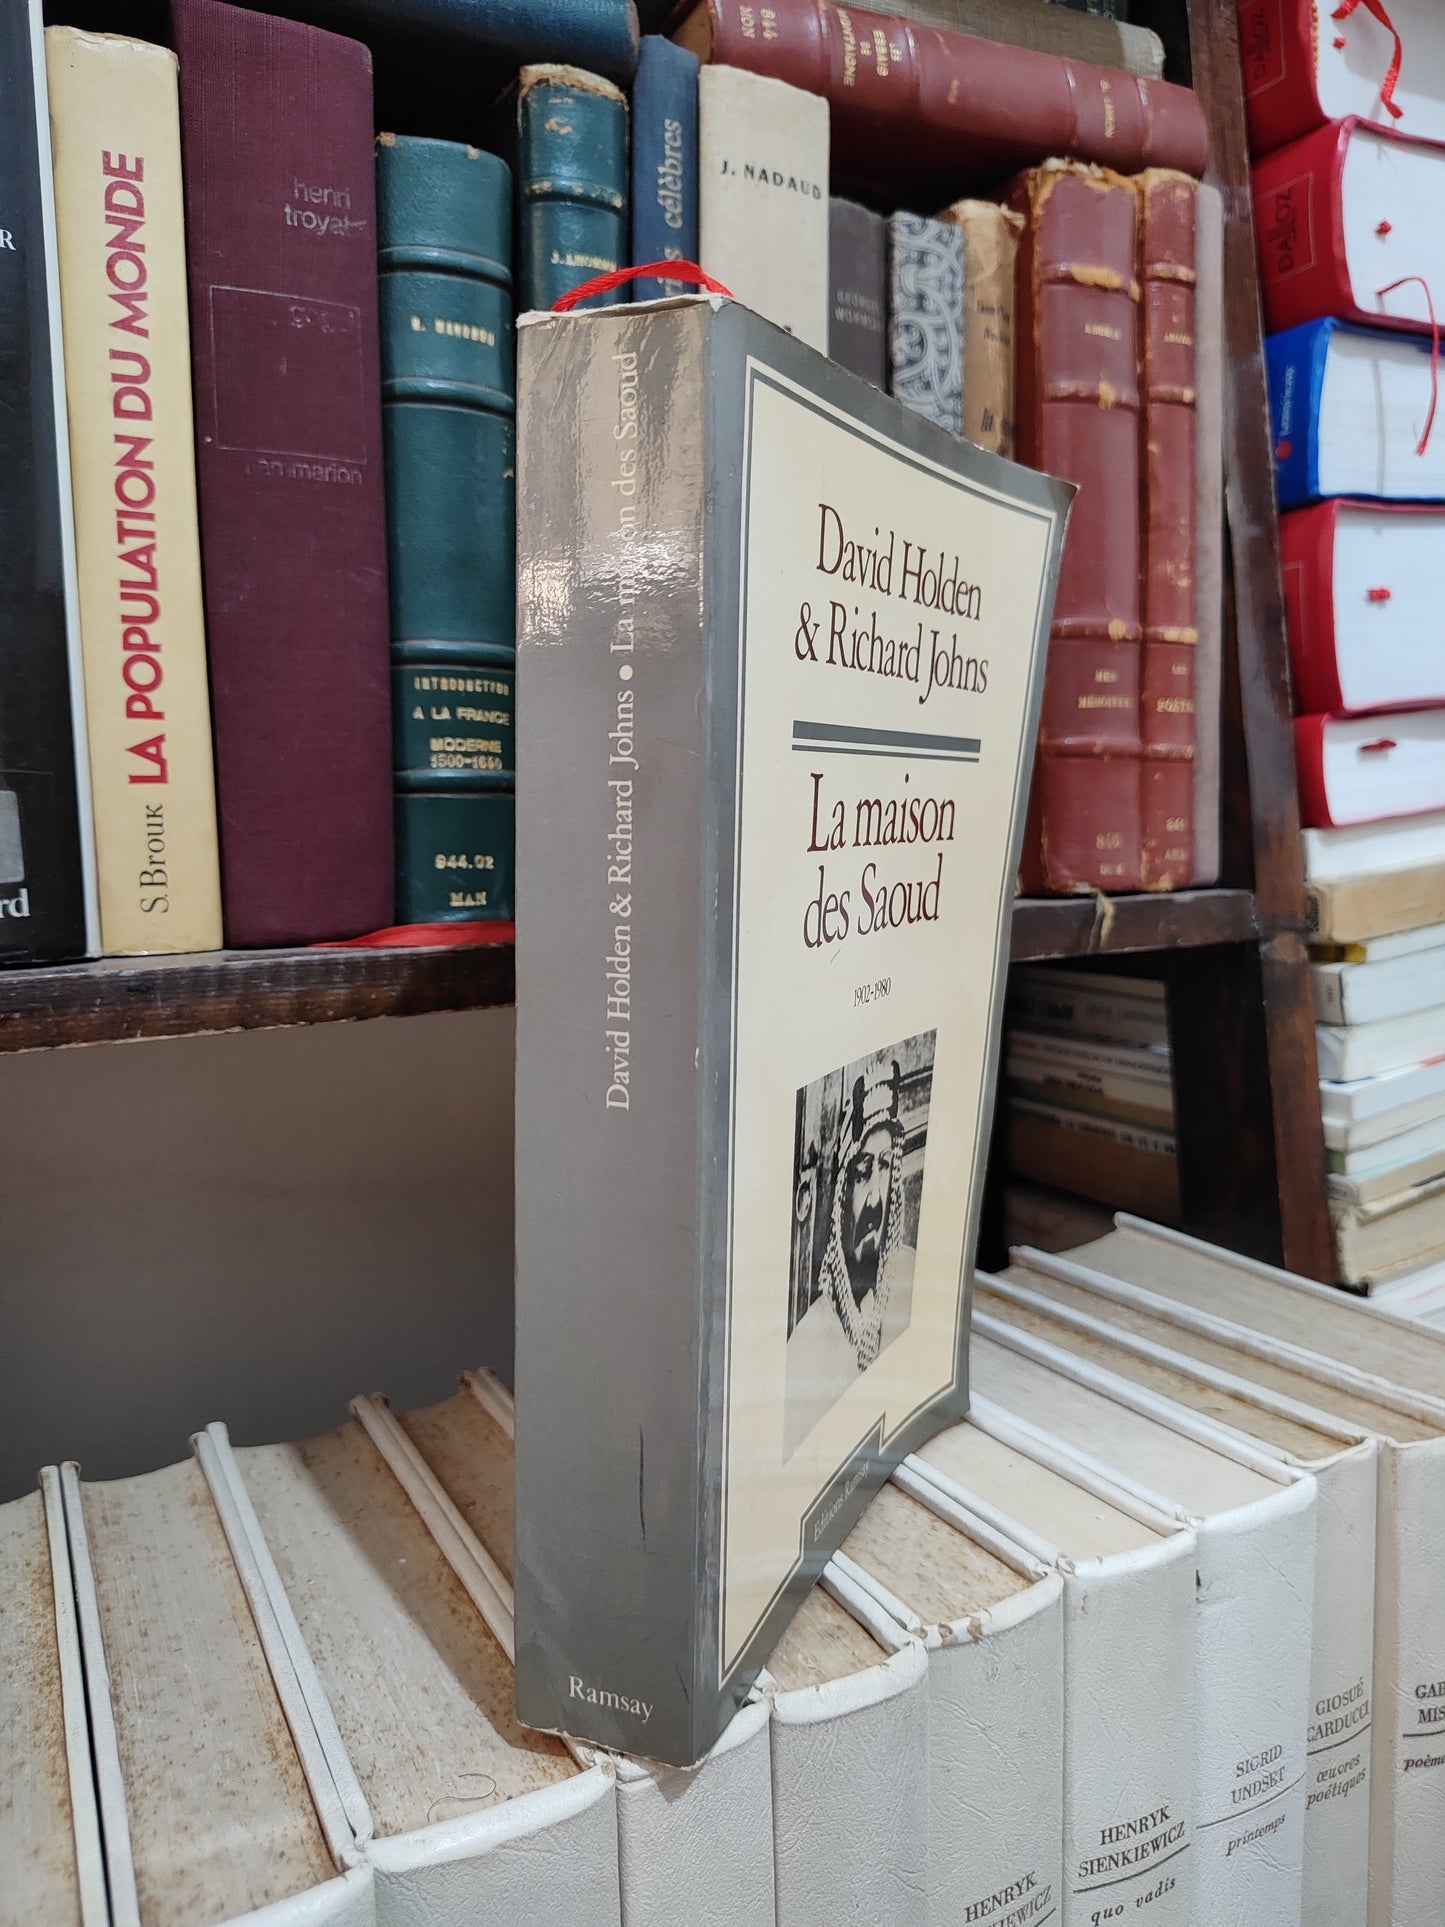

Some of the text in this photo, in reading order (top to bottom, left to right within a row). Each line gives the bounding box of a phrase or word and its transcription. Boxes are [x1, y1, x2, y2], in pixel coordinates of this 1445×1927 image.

[739, 5, 756, 39] MON
[759, 7, 778, 40] 844
[836, 8, 856, 87] MONTAIGNE
[872, 29, 890, 77] ESSAIS
[293, 177, 351, 209] henri
[656, 118, 683, 229] célèbres
[720, 160, 822, 200] J. NADAUD
[612, 350, 638, 441] Saoud
[101, 149, 169, 785] LA POPULATION DU MONDE
[611, 450, 637, 497] des
[816, 503, 982, 622] David Holden
[610, 617, 635, 654] La
[794, 600, 989, 705] & Richard Johns
[430, 706, 452, 720] LA
[456, 706, 510, 726] FRANCE
[609, 689, 640, 771] Johns
[429, 737, 503, 753] MODERNE
[607, 778, 633, 885] Richard
[806, 772, 956, 853] La maison
[139, 890, 169, 914] S.
[608, 892, 632, 918] &
[803, 852, 944, 949] des Saoud
[606, 924, 631, 1022] Holden
[853, 976, 893, 1008] 1902-1980
[606, 1030, 630, 1112] David
[568, 1674, 654, 1724] Ramsay
[1315, 1677, 1365, 1717] GIOSUÉ
[1306, 1699, 1370, 1743] CARDUCCI
[1230, 1766, 1286, 1804] UNDSET
[1235, 1744, 1283, 1779] SIGRID
[1304, 1767, 1367, 1810] poétiques
[1078, 1820, 1186, 1878] SIENKIEWICZ
[1099, 1805, 1172, 1846] HENRYK
[1225, 1813, 1286, 1857] printemps
[964, 1870, 1038, 1924] HENRYK
[1091, 1876, 1177, 1927] quo vadis
